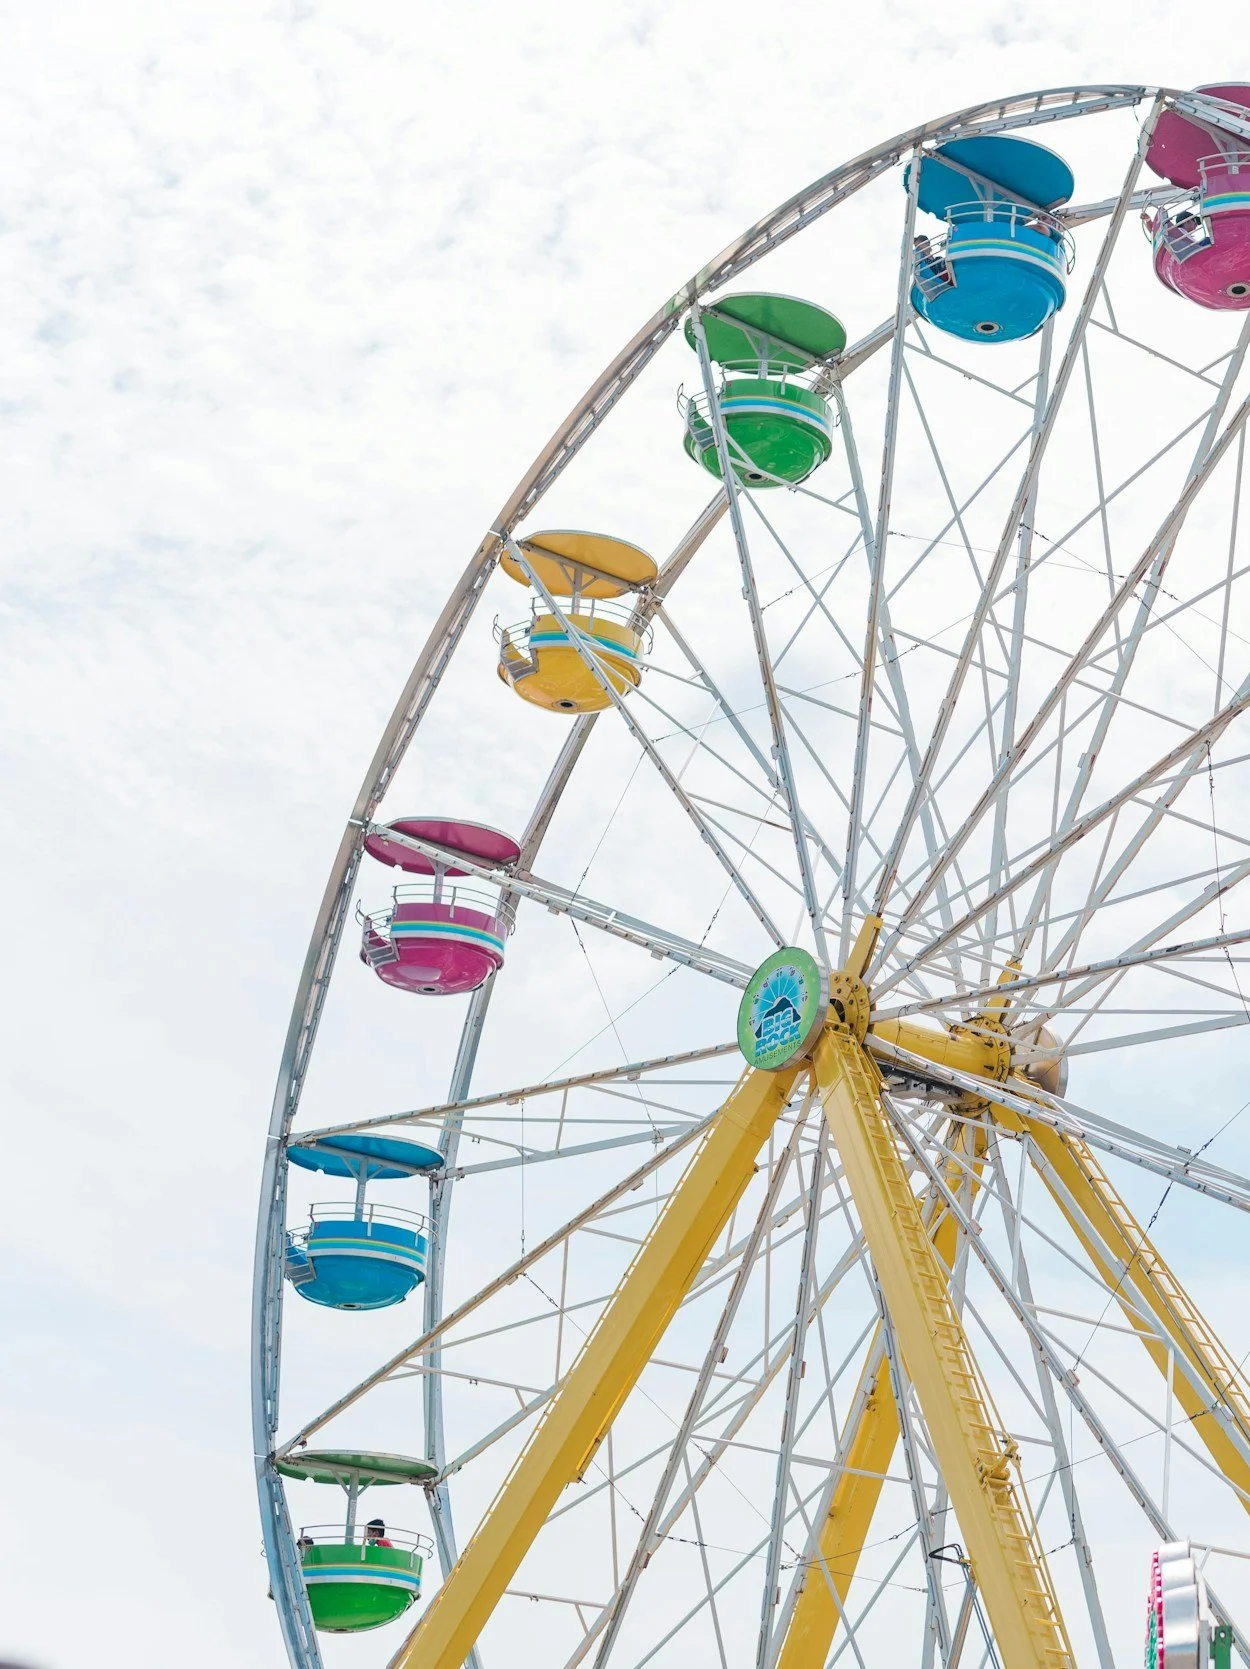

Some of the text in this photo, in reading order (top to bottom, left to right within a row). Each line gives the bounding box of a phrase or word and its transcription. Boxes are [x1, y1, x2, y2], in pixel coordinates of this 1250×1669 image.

[762, 1007, 793, 1037] BIG
[754, 1040, 801, 1065] AMUSEMENTS
[755, 1023, 801, 1057] ROCK
